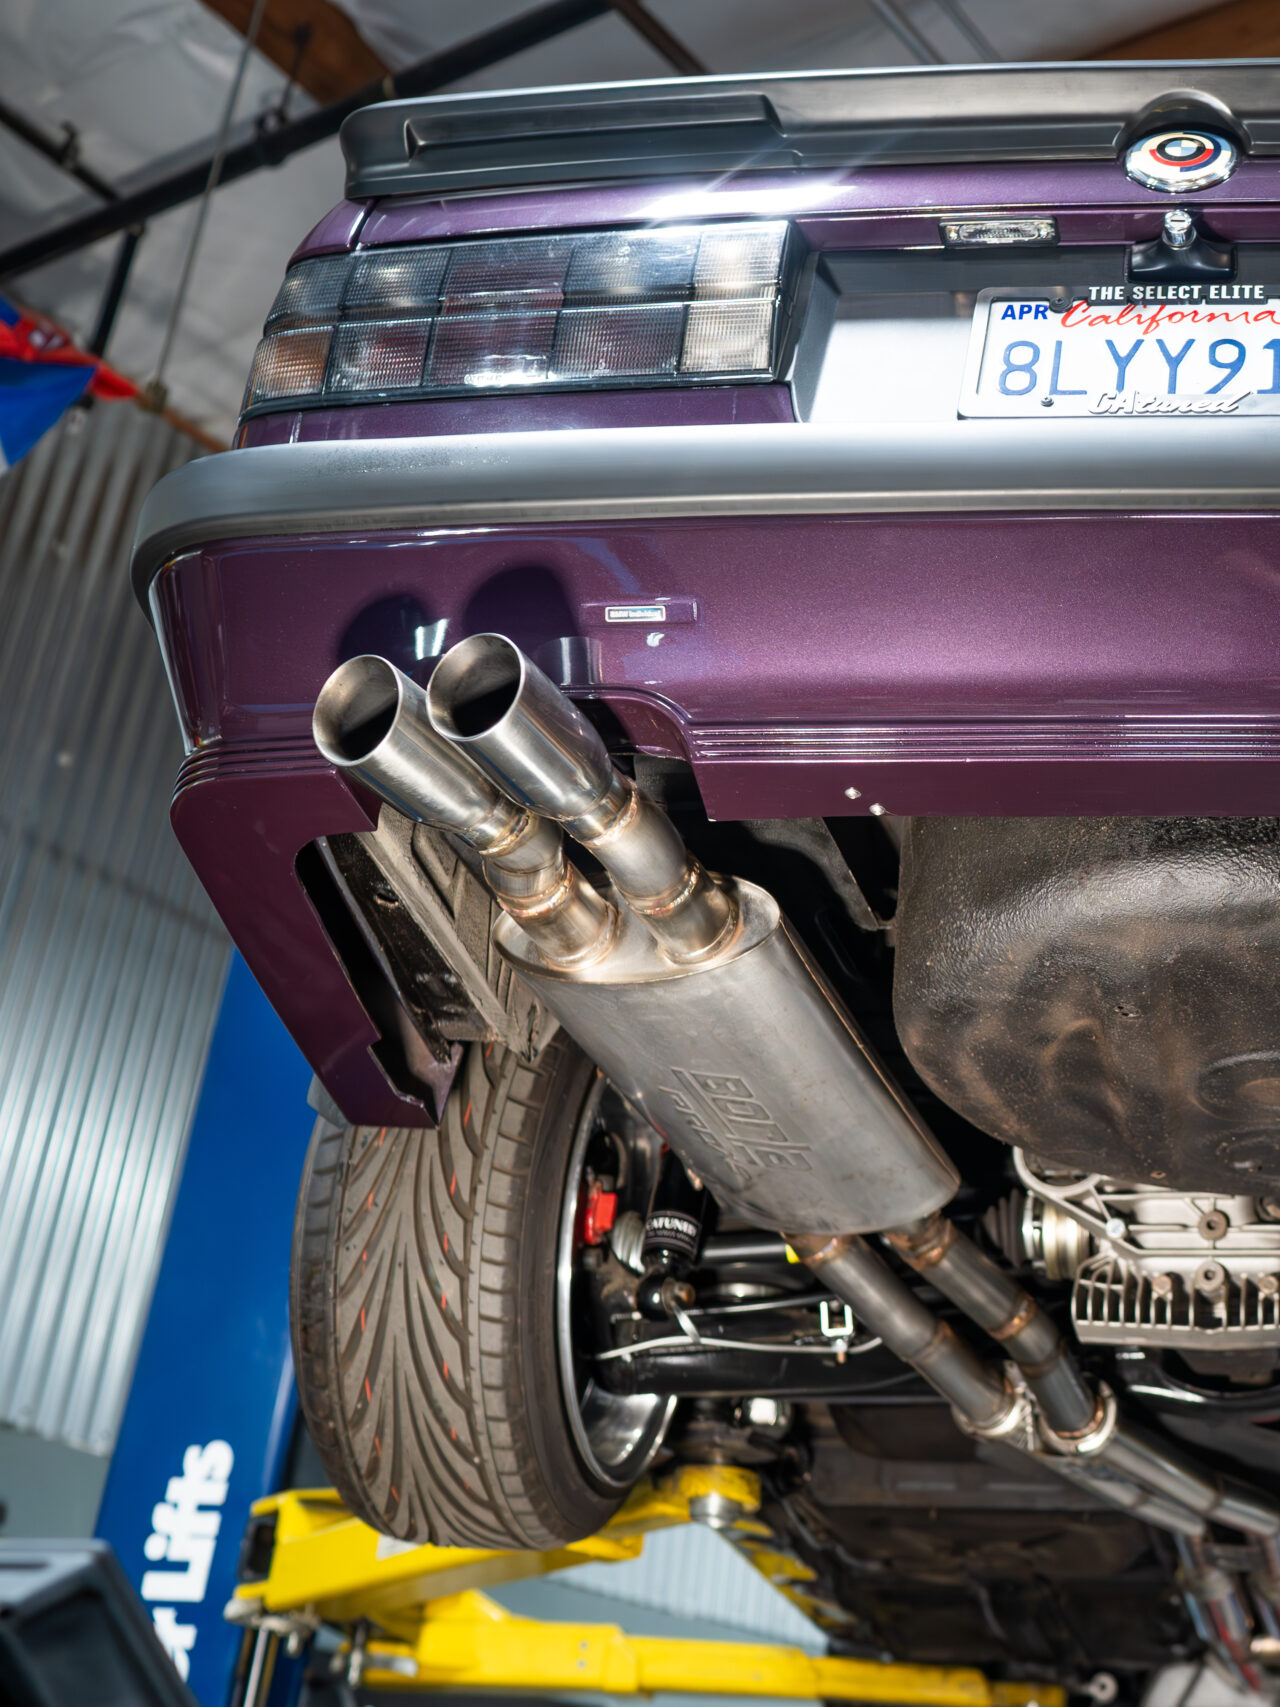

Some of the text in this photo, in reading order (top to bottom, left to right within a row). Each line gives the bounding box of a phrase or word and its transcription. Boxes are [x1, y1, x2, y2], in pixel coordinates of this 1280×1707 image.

[1089, 284, 1264, 300] THE SELECT ELITE
[1001, 303, 1049, 320] APR
